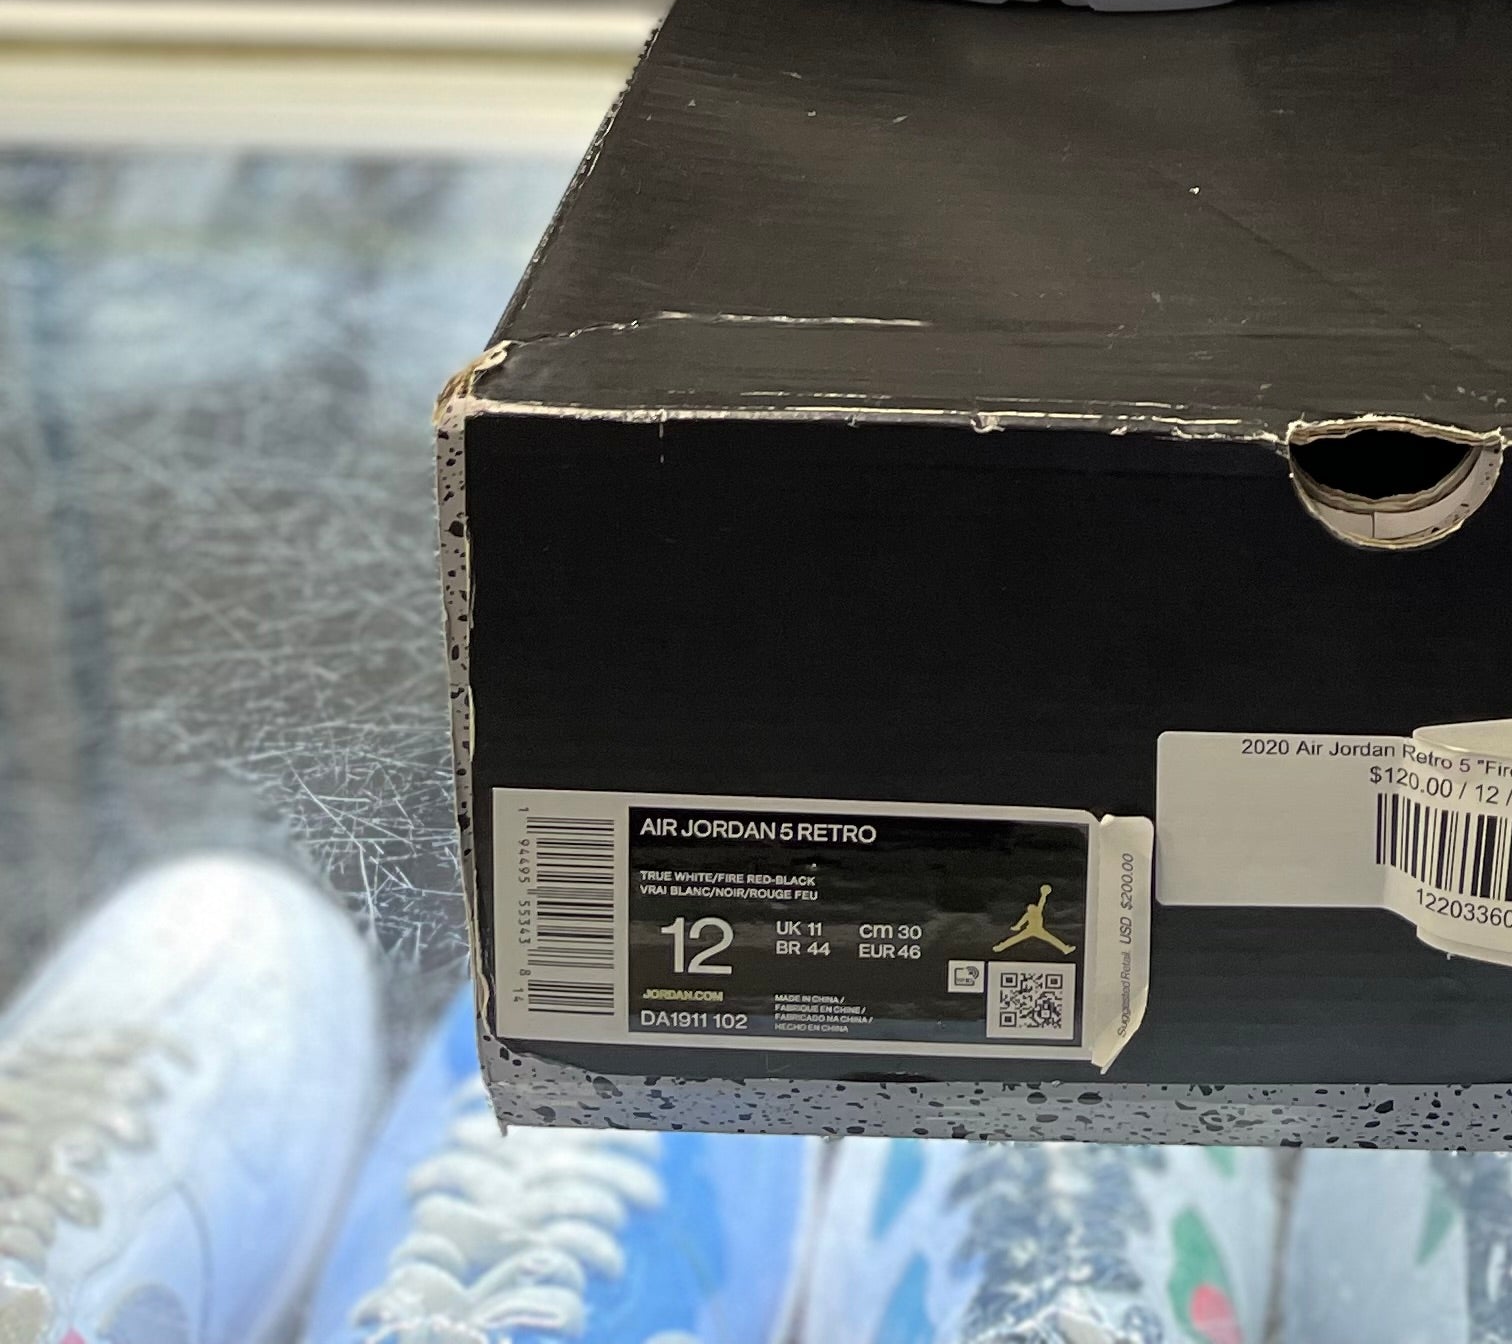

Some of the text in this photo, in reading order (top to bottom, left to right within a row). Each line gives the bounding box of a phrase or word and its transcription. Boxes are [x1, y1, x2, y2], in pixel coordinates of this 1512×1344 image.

[1241, 739, 1290, 755] 2020
[1296, 740, 1323, 755] Air
[1328, 742, 1395, 757] Jordan
[1402, 744, 1453, 770] Retro
[1459, 758, 1471, 773] 5
[1370, 766, 1453, 798] $120.00
[1458, 781, 1468, 800] /
[1476, 784, 1500, 804] 12
[640, 818, 877, 843] AIR JORDAN 5 RETRO
[518, 839, 529, 884] 94495
[640, 870, 816, 887] TRUE WHITE/FIRE RED-BLACK
[640, 884, 818, 901] VRAI BLANC/NOIR/ROUGE FEU
[518, 900, 530, 944] 55343
[776, 921, 823, 937] UK 11
[898, 924, 922, 940] 30
[661, 917, 734, 975] 12
[776, 941, 831, 956] BR 44
[859, 944, 921, 960] EUR 46
[1117, 852, 1134, 1037] Suggested Retail USD $200.00
[519, 969, 530, 977] 8
[643, 989, 723, 1002] JORDAN.COM
[775, 994, 800, 1002] MADE
[812, 995, 839, 1003] CHINA
[820, 1005, 833, 1013] EN
[641, 1010, 748, 1030] DA1911 102
[827, 1015, 839, 1023] NA
[840, 1015, 867, 1023] CHINA
[808, 1024, 820, 1032] EN
[821, 1025, 848, 1033] CHINA
